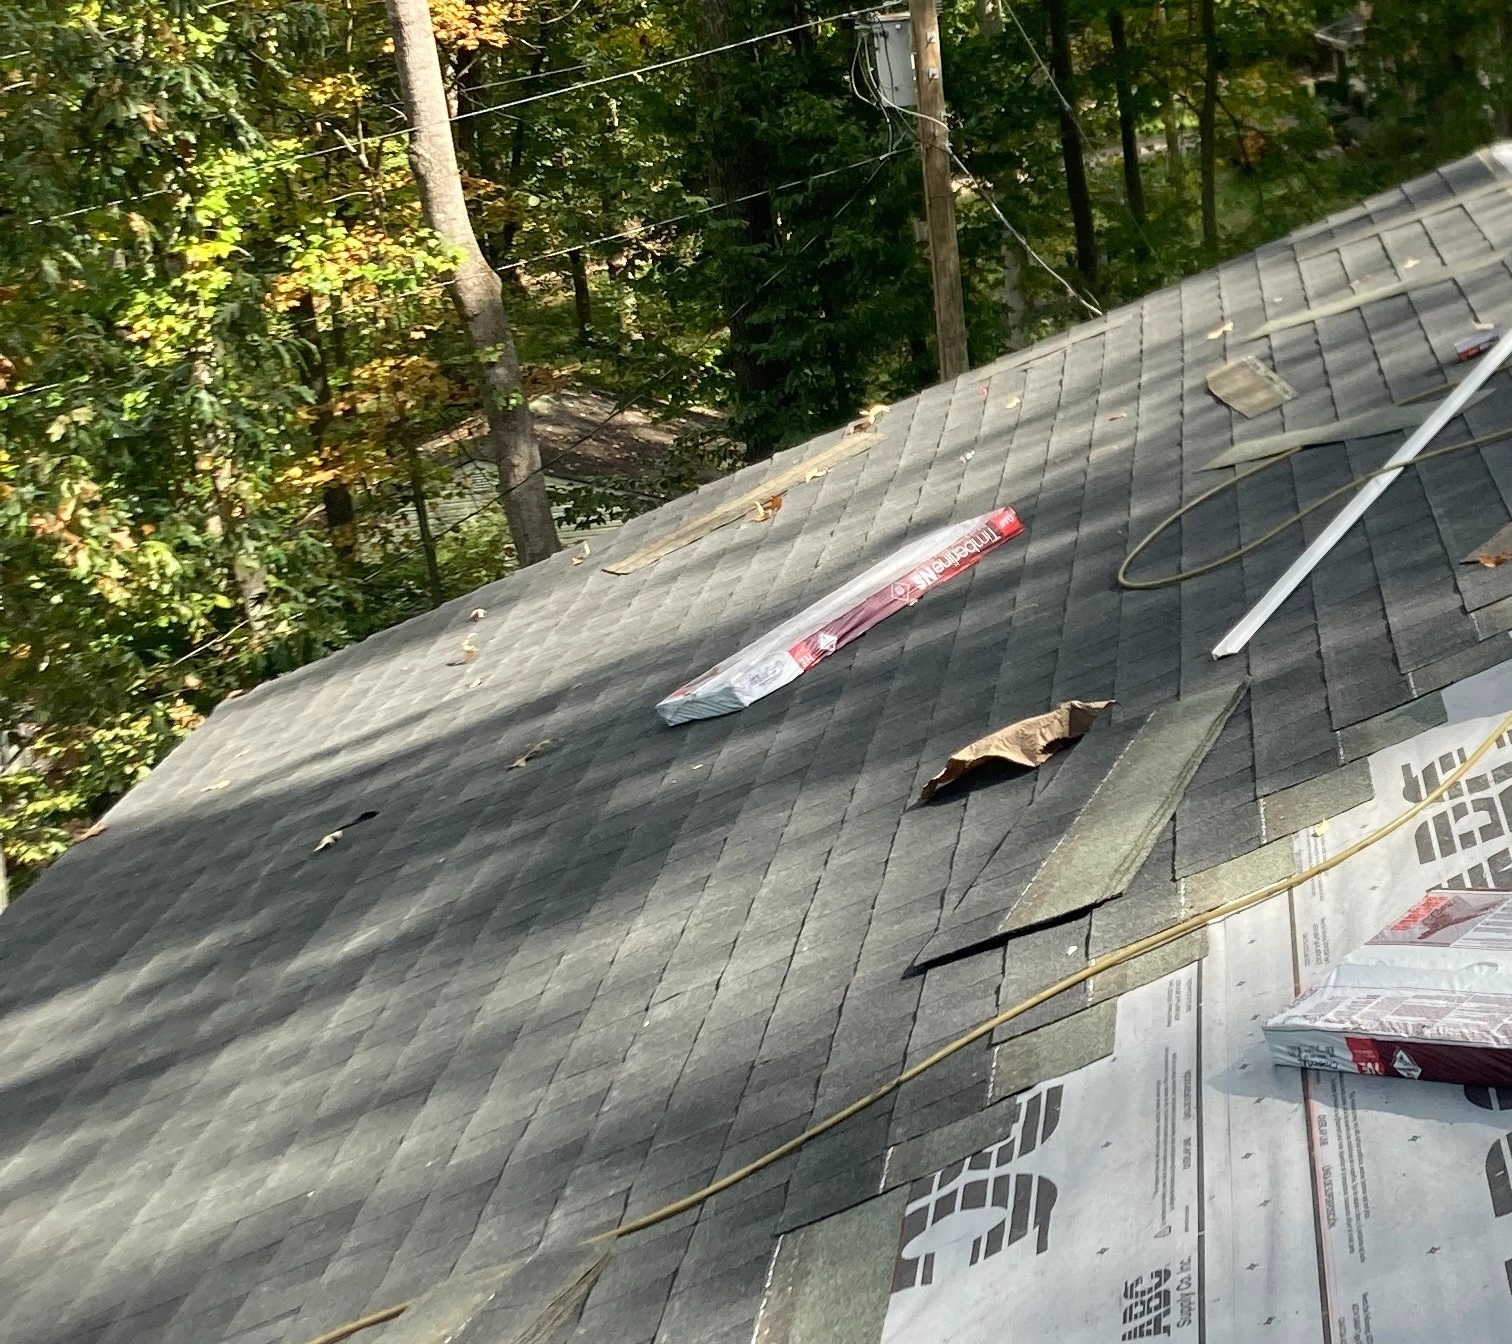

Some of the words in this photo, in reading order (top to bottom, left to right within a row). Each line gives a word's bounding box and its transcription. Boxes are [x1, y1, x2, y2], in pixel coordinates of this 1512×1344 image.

[933, 526, 1002, 575] Timberline
[1121, 1265, 1172, 1343] ABC
[1177, 1290, 1195, 1330] Supply
